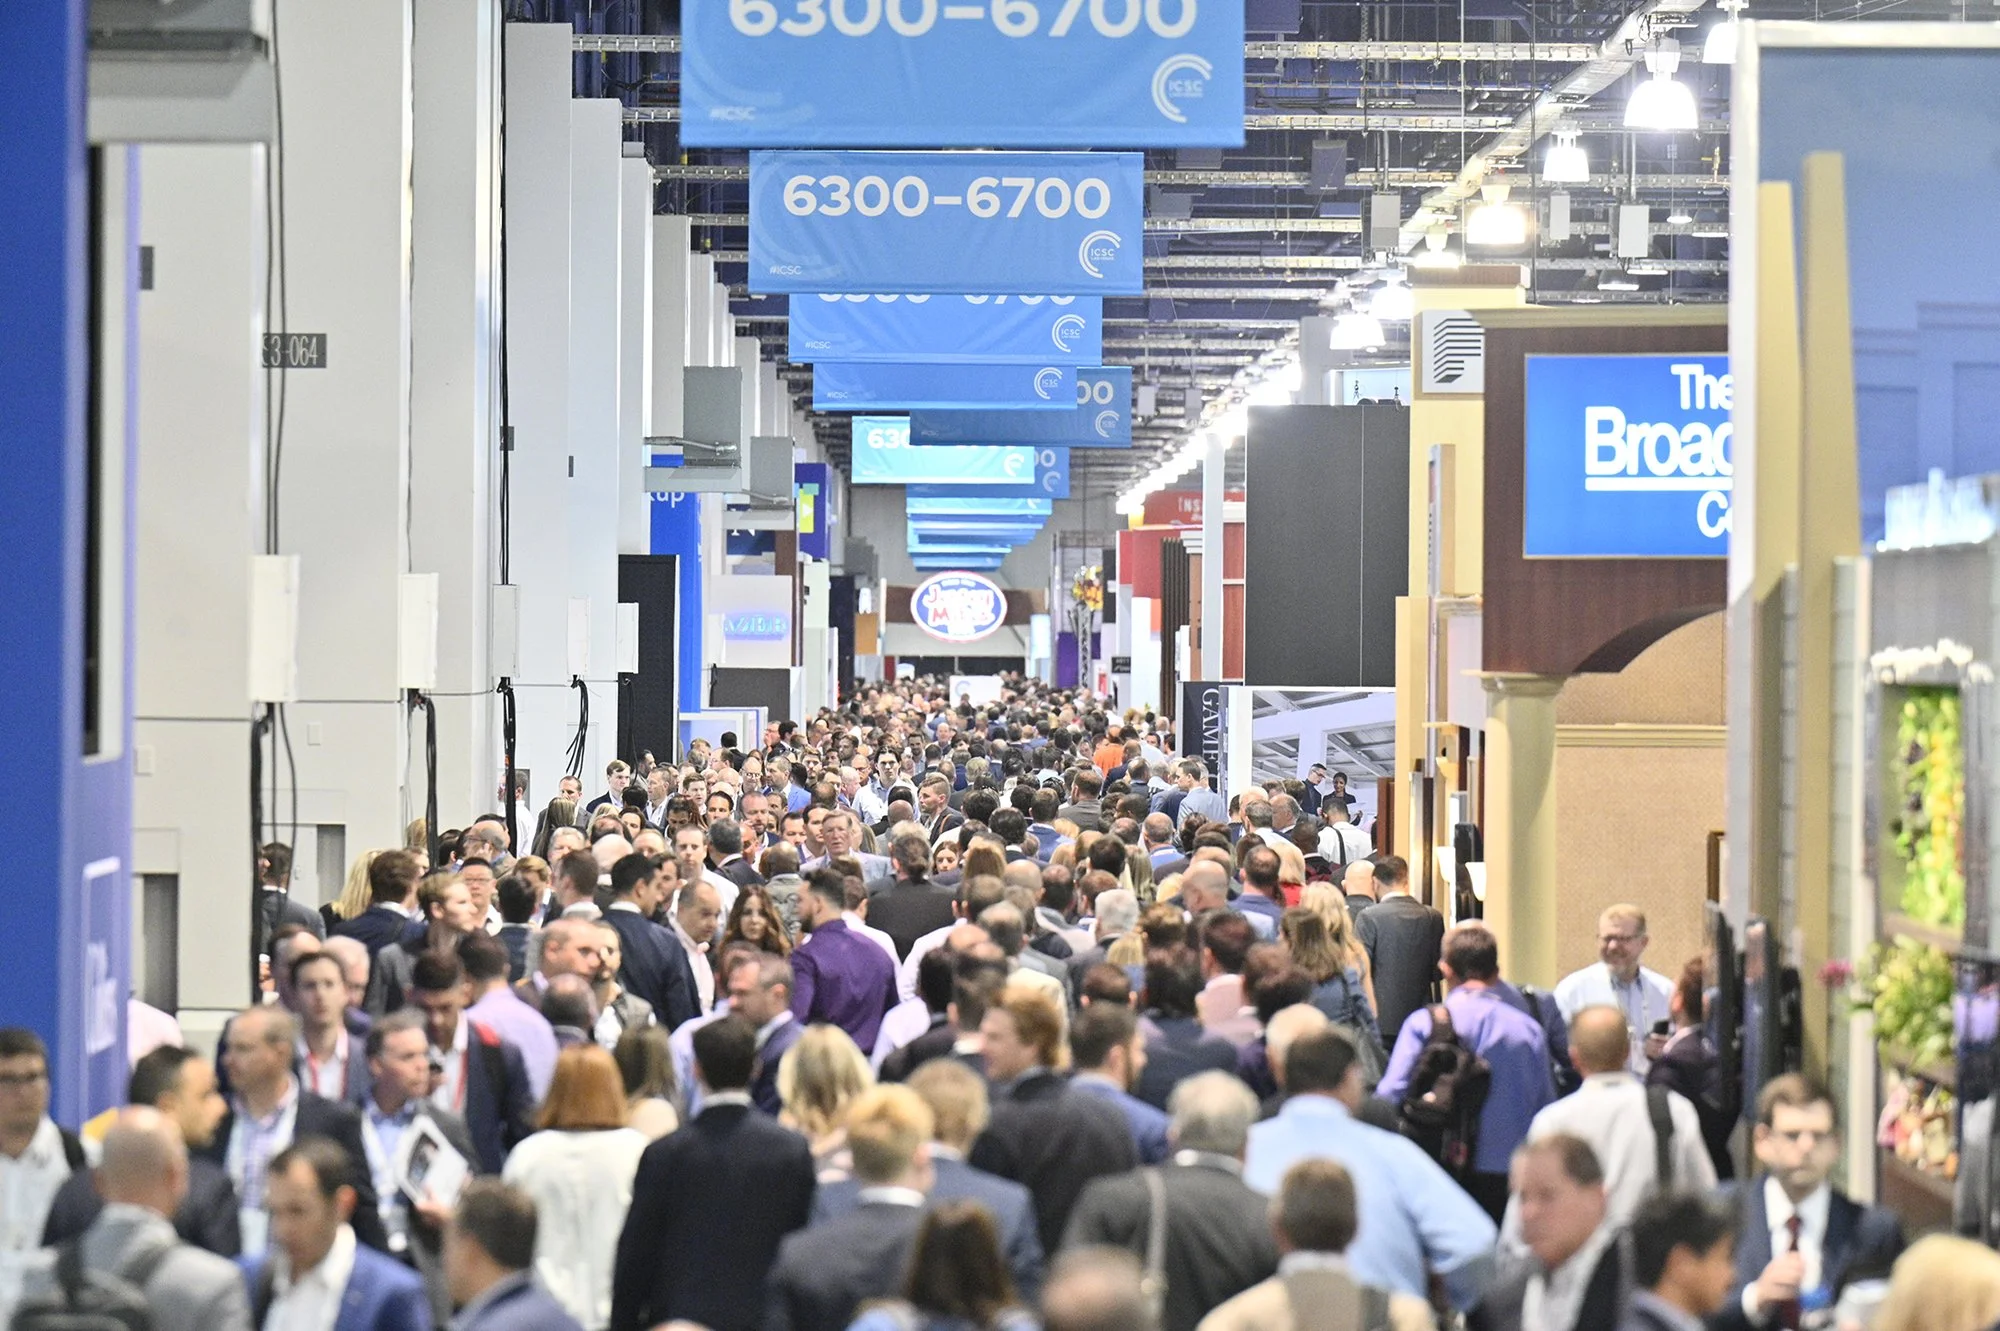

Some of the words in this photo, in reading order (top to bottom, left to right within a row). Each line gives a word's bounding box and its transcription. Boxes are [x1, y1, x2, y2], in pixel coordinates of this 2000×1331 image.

[1091, 248, 1115, 257] ICSC
[770, 265, 801, 275] #ICSC
[1061, 328, 1081, 336] ICSC
[805, 341, 831, 349] #ICSC
